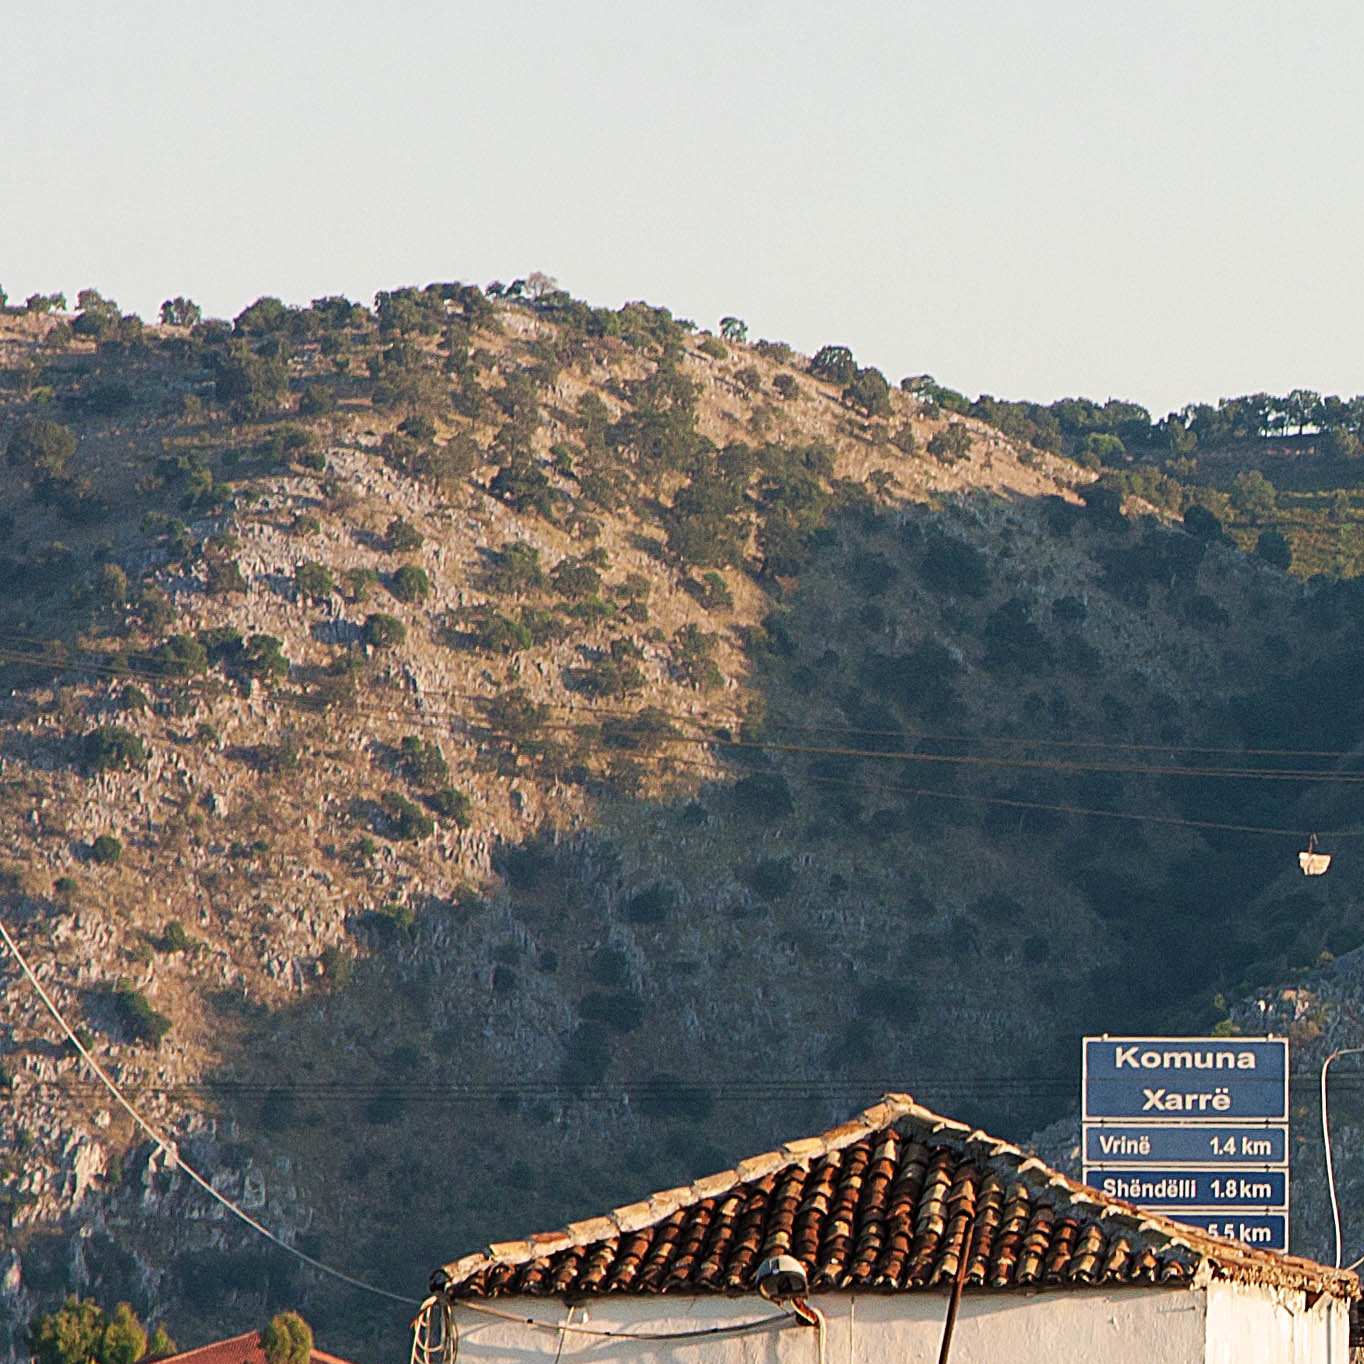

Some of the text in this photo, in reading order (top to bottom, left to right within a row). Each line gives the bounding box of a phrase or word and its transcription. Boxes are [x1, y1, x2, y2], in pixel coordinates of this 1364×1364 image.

[1115, 1046, 1256, 1069] Komuna
[1142, 1088, 1231, 1111] Xarrë
[1099, 1135, 1272, 1155] Vrinë 1.4 km
[1103, 1178, 1272, 1198] Shëndëlli 1.8 km
[1240, 1223, 1272, 1242] km
